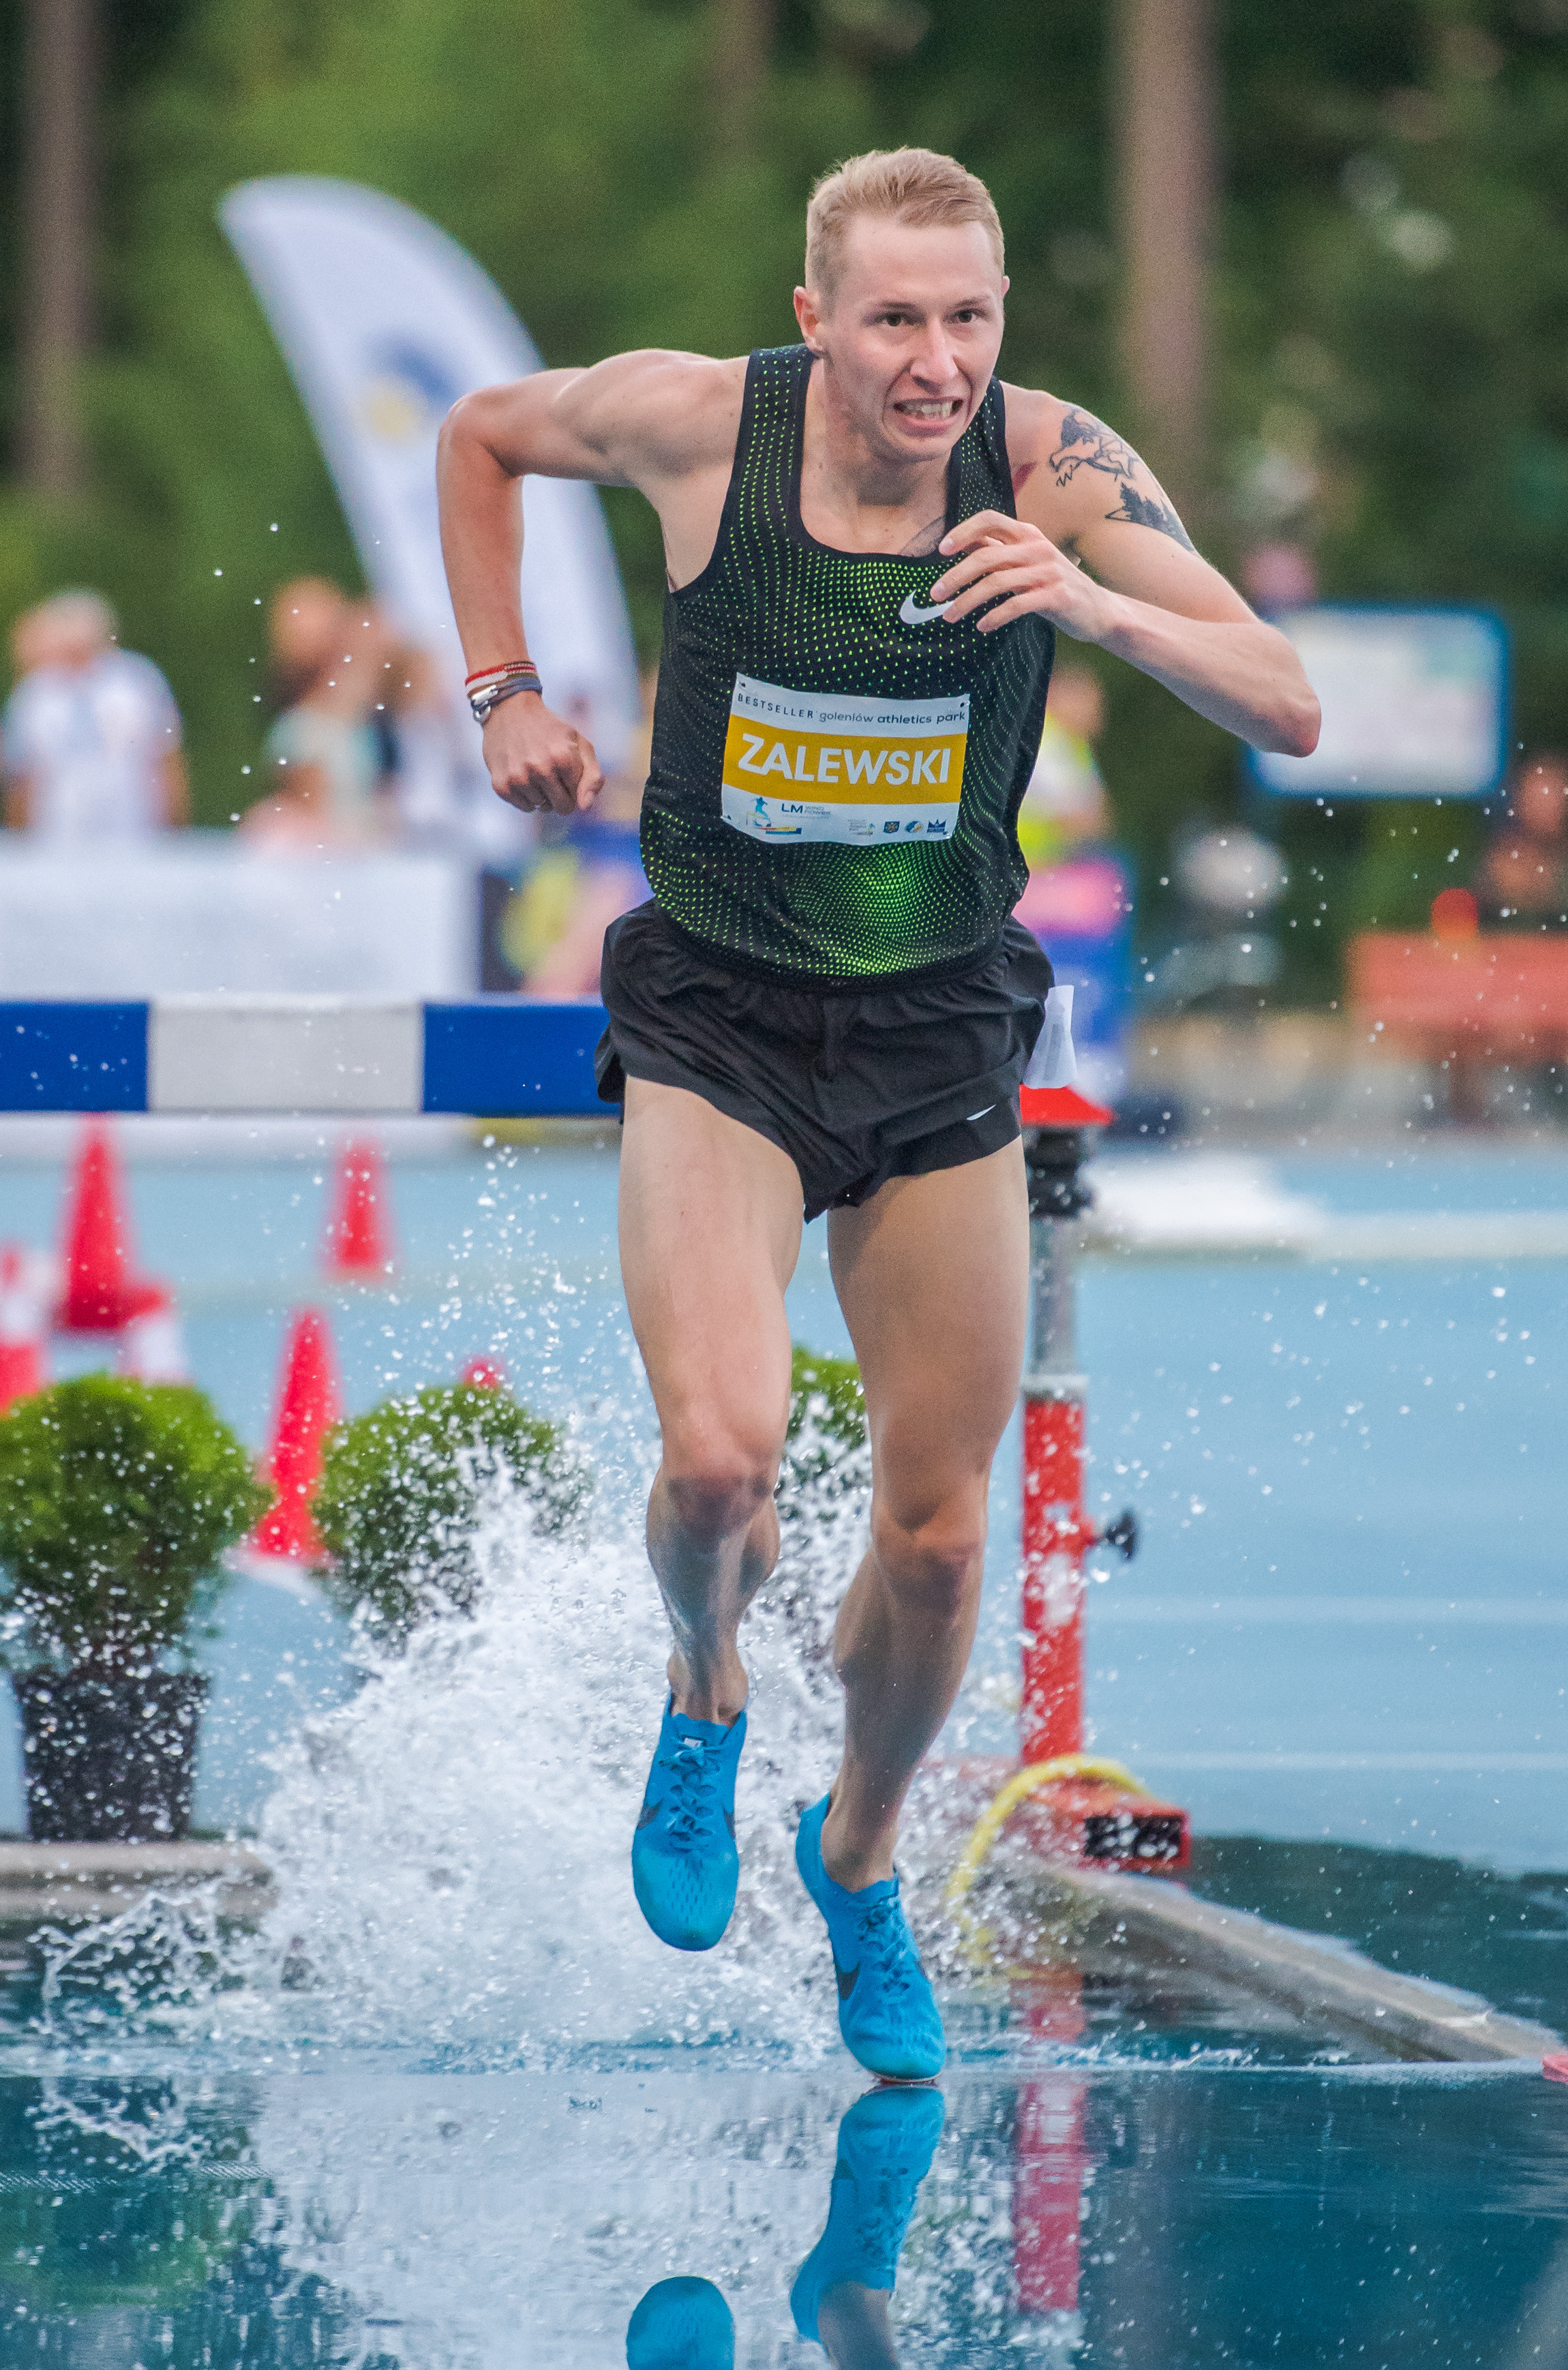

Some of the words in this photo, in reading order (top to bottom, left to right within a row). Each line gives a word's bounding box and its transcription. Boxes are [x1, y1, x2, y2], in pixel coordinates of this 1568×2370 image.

[738, 693, 814, 718] BESTSELLER
[819, 711, 873, 723] goleniów
[877, 714, 932, 724] athletics
[937, 711, 965, 725] park
[738, 733, 951, 785] ZALEWSKI
[781, 802, 803, 813] LM
